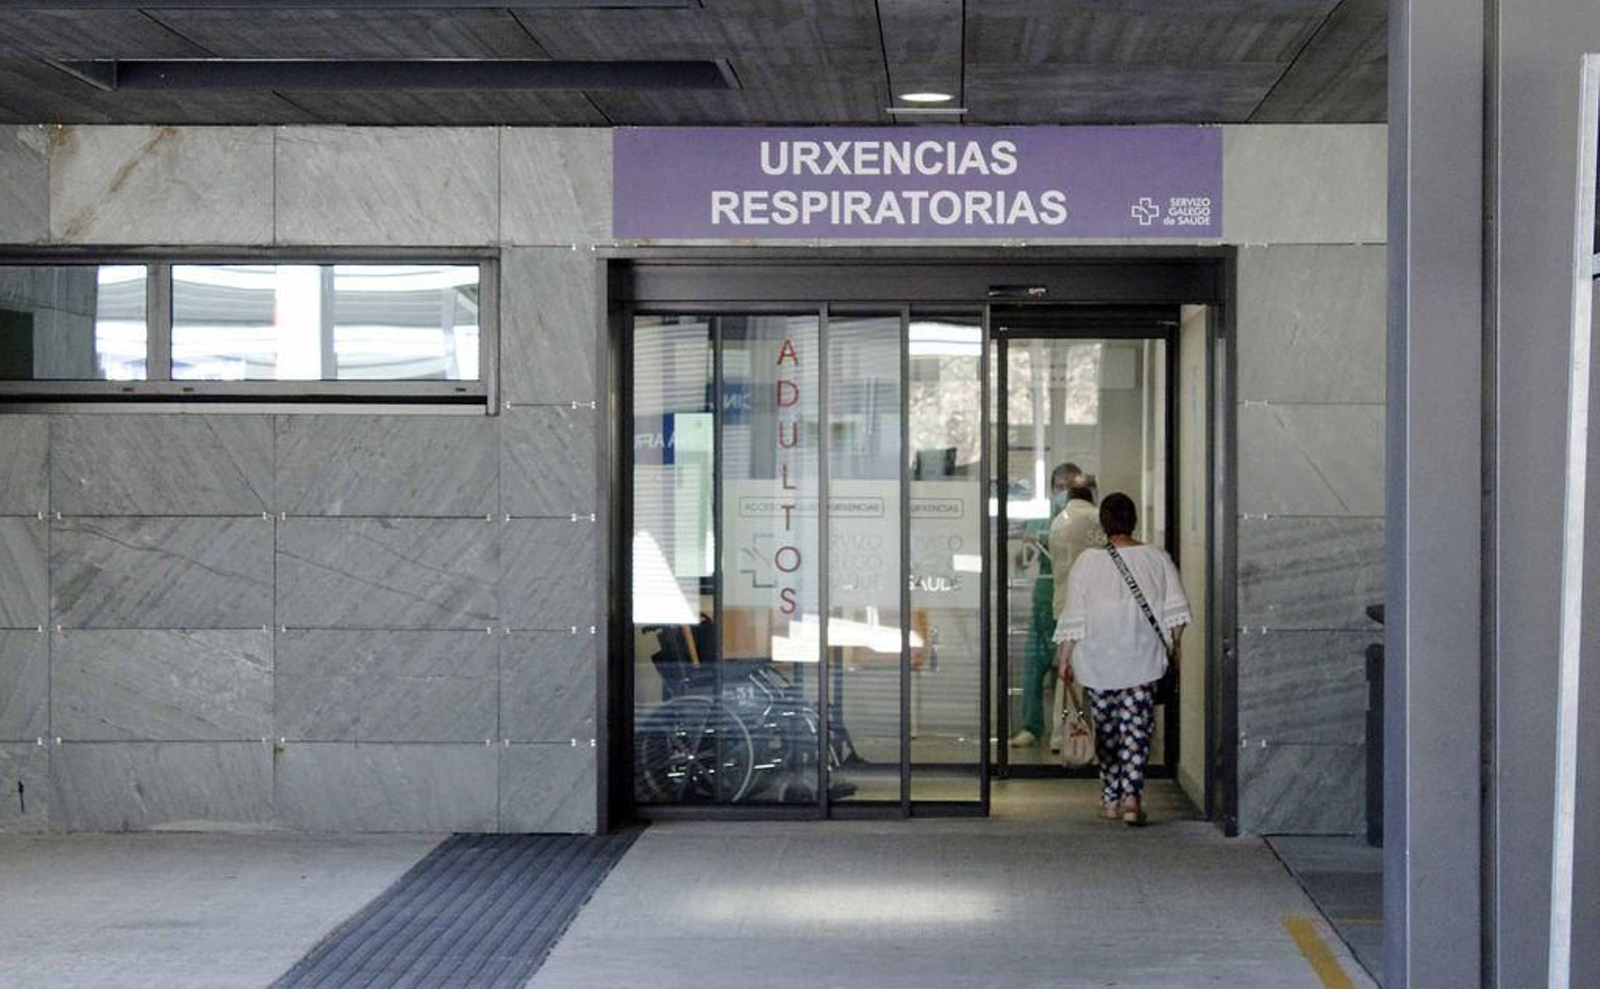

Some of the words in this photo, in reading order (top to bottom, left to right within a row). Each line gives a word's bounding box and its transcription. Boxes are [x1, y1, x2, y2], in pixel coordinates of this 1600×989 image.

[759, 140, 1019, 176] URXENCIAS
[710, 190, 1068, 226] RESPIRATORIAS
[1168, 206, 1211, 217] GALEGO
[1170, 197, 1211, 207] SERVIZO
[1163, 216, 1176, 225] de
[775, 339, 801, 615] ADULTOS
